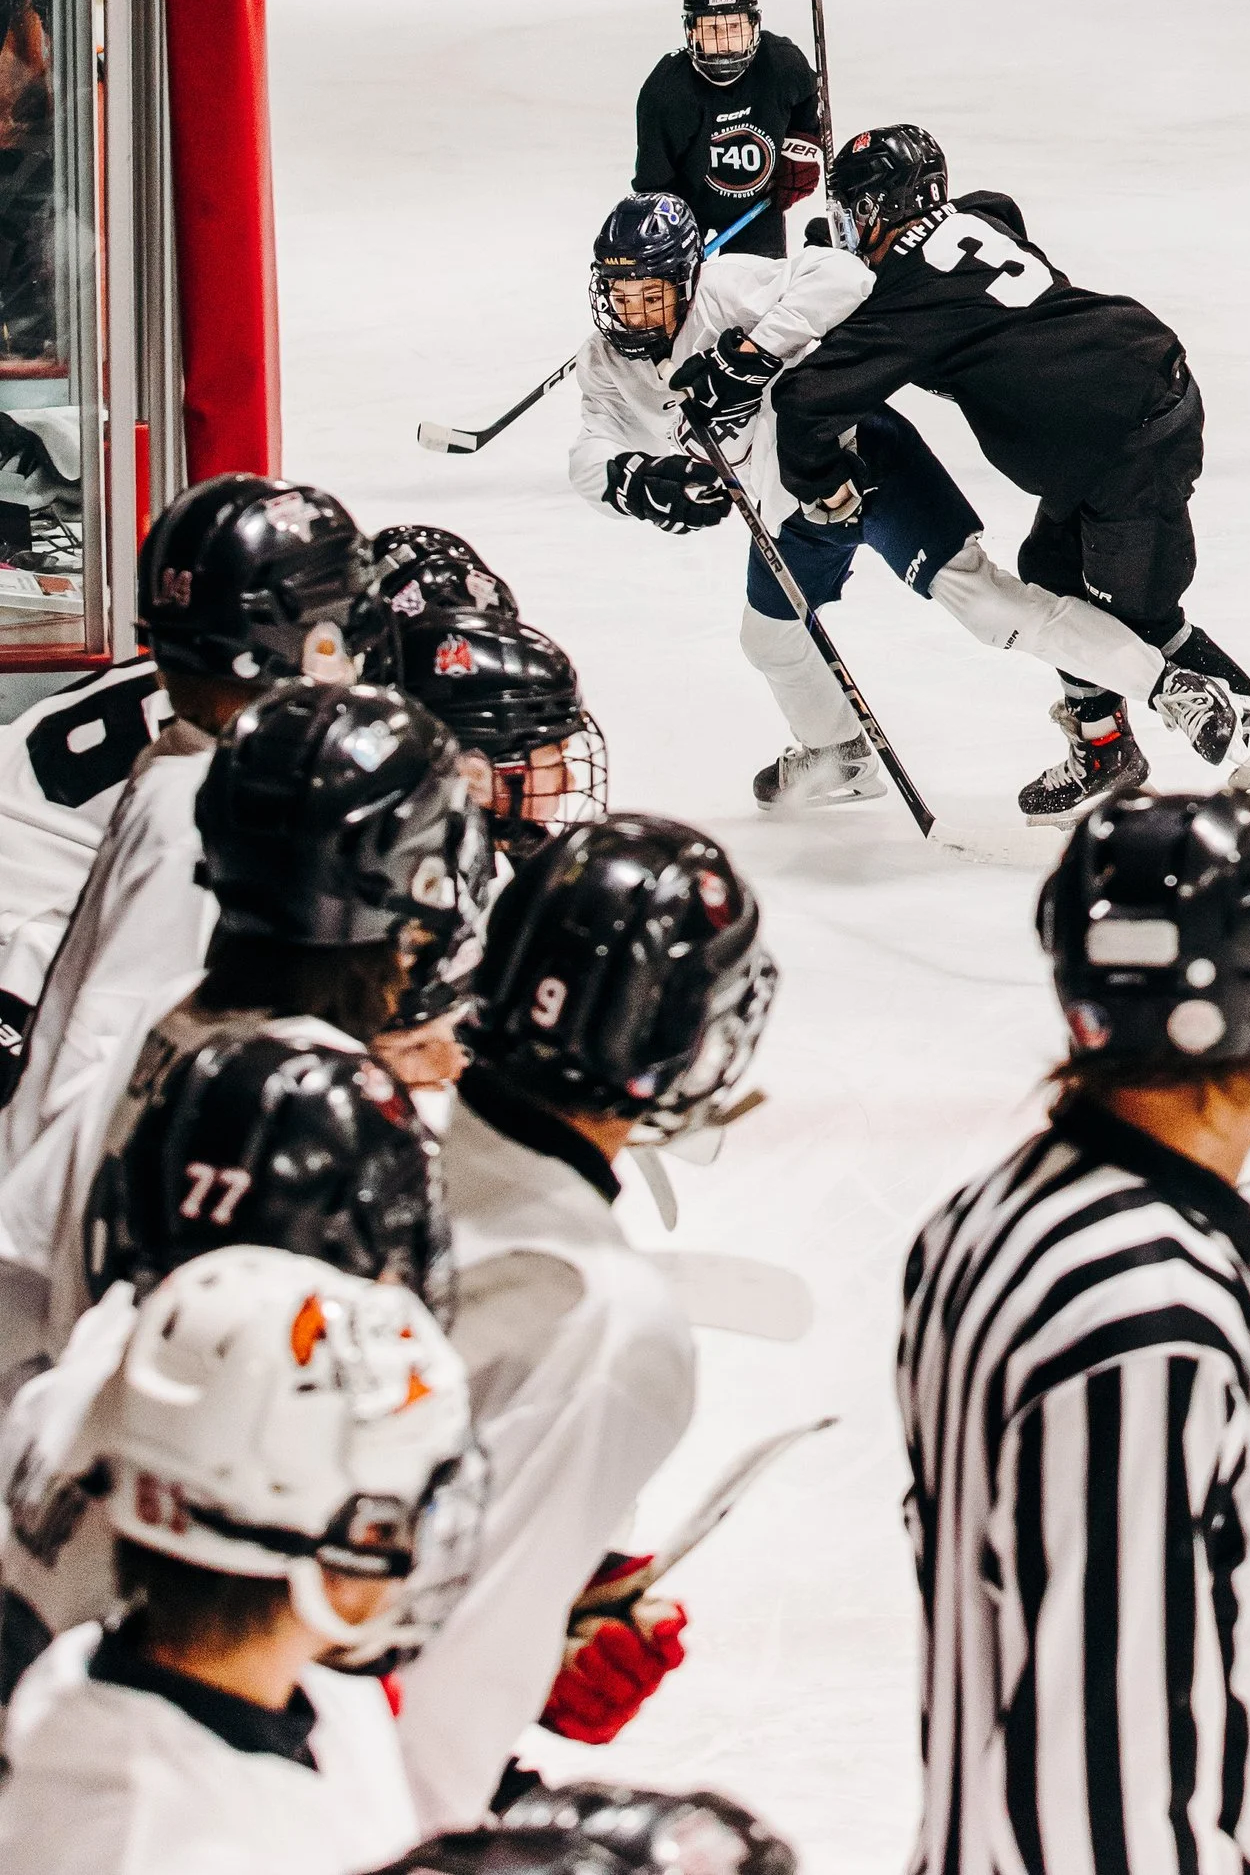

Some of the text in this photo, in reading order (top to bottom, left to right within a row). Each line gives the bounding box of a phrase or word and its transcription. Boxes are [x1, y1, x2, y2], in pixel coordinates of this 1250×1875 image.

[716, 107, 752, 123] CCM
[921, 212, 1055, 309] 3
[710, 350, 769, 385] RUE
[531, 976, 569, 1027] 9
[179, 1162, 252, 1226] 77
